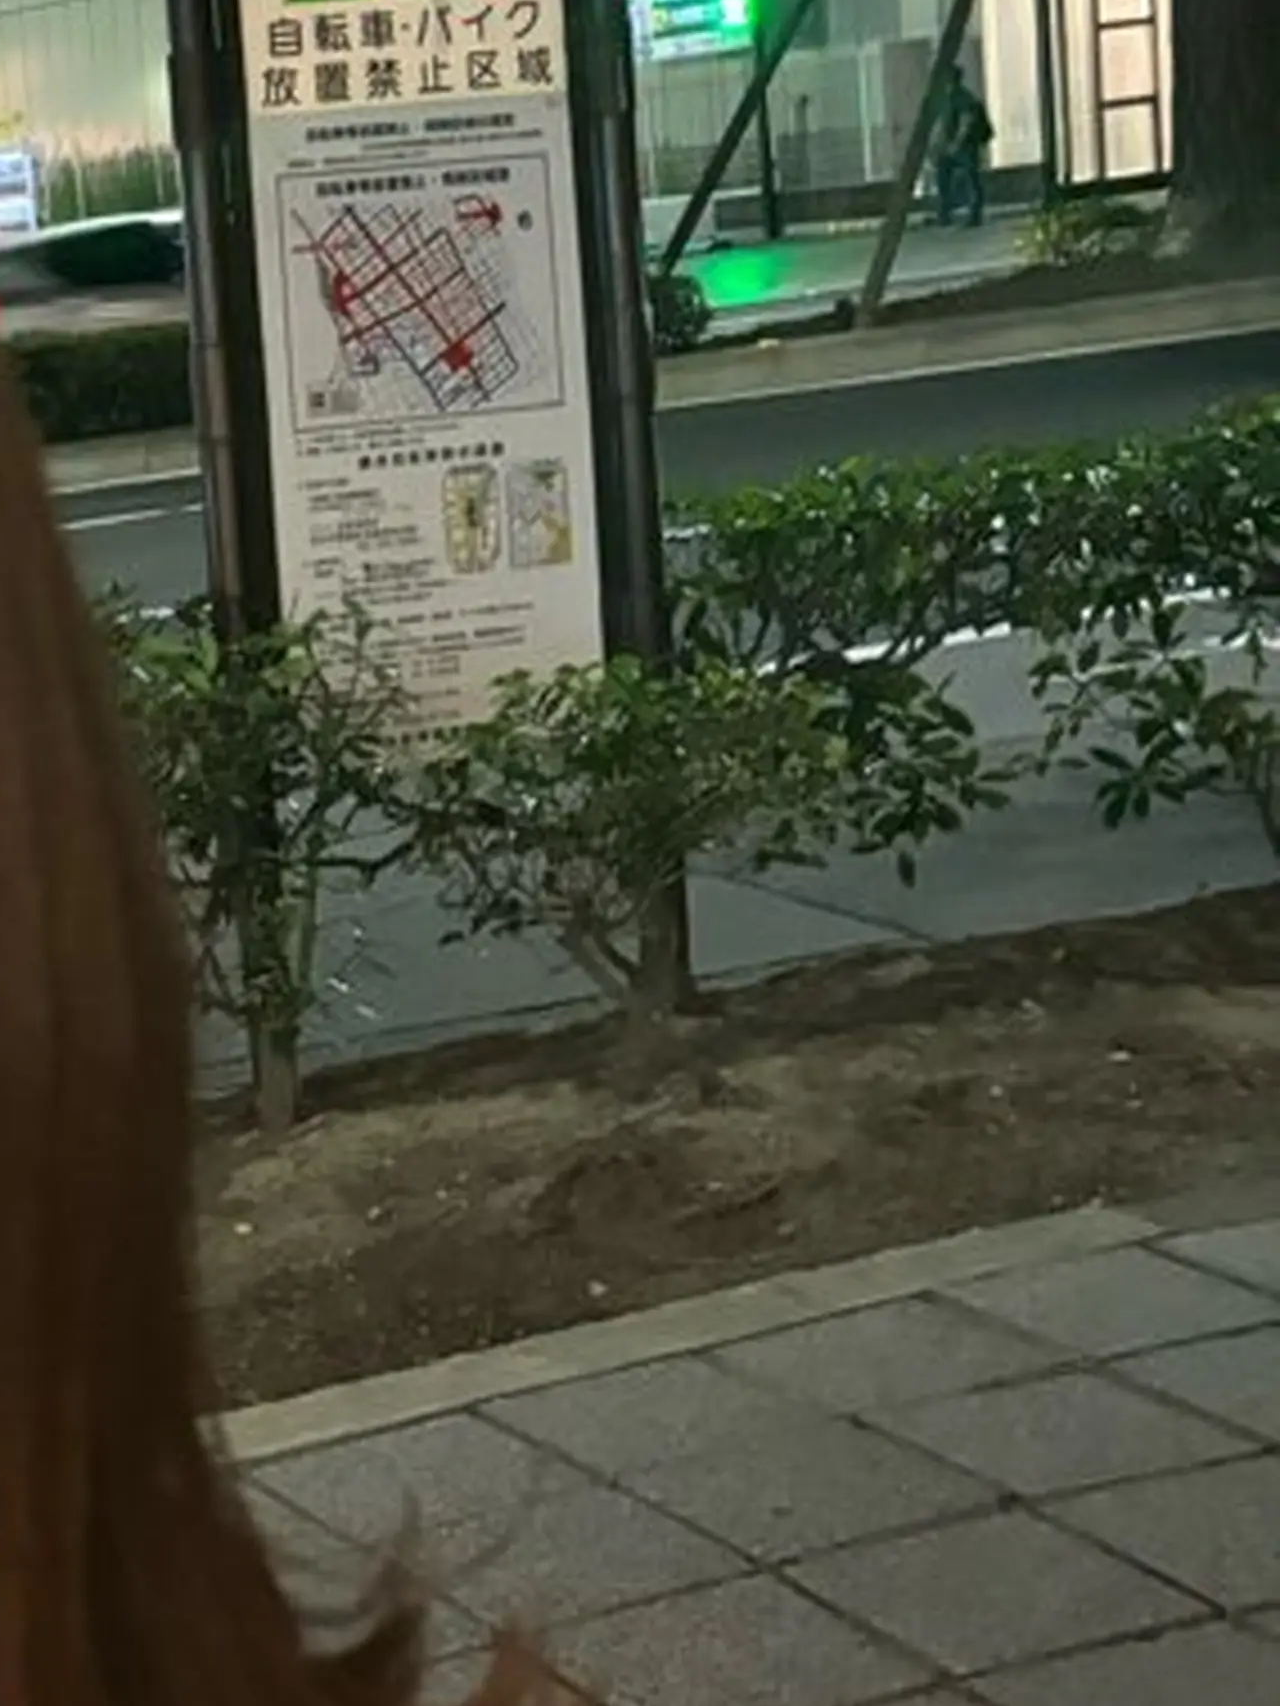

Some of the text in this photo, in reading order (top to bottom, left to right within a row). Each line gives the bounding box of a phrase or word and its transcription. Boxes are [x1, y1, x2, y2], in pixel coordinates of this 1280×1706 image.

[267, 0, 539, 59] 自転車・バイク
[261, 45, 553, 107] 放置禁止区域
